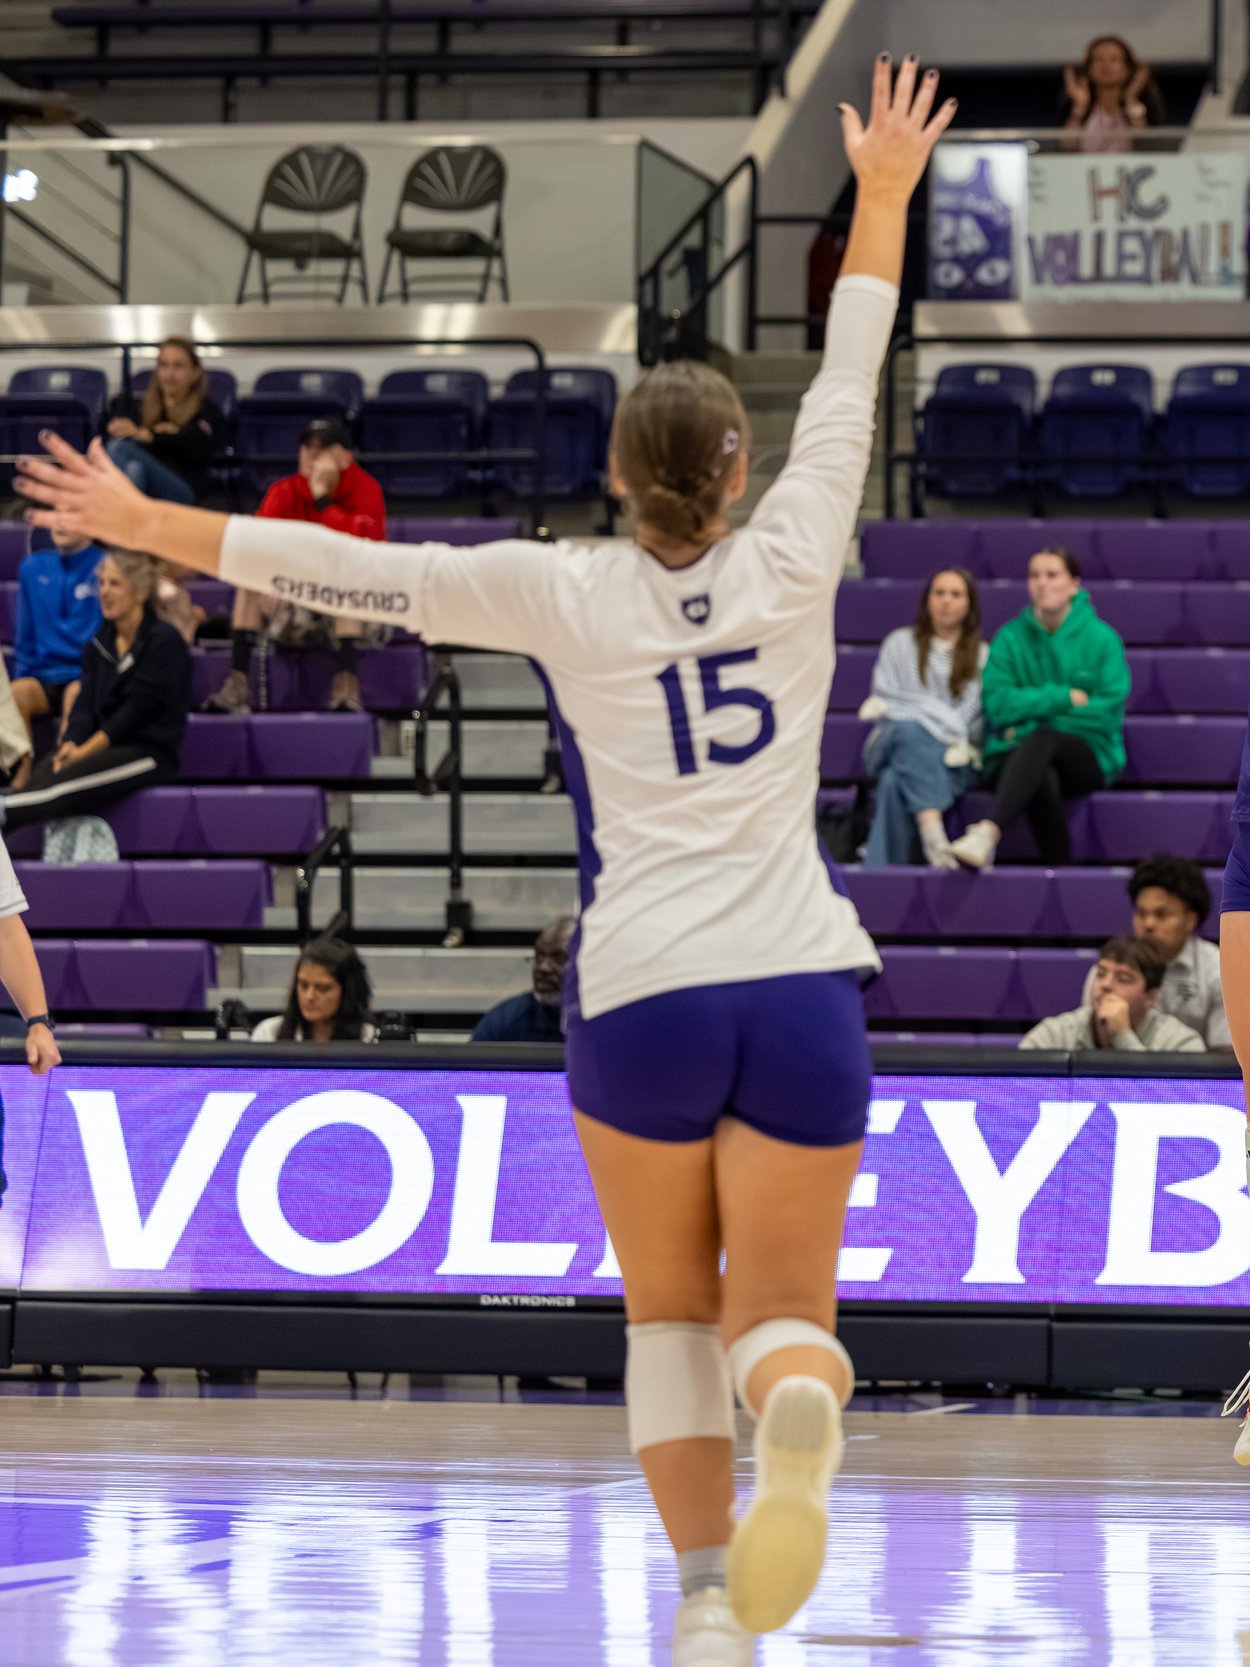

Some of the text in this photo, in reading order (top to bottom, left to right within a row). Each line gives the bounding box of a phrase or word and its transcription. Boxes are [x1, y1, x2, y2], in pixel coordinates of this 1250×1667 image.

[1087, 164, 1170, 223] HC
[271, 575, 410, 613] CRUSADERS
[656, 646, 776, 776] 15
[480, 1294, 577, 1307] DAKTRONICS
